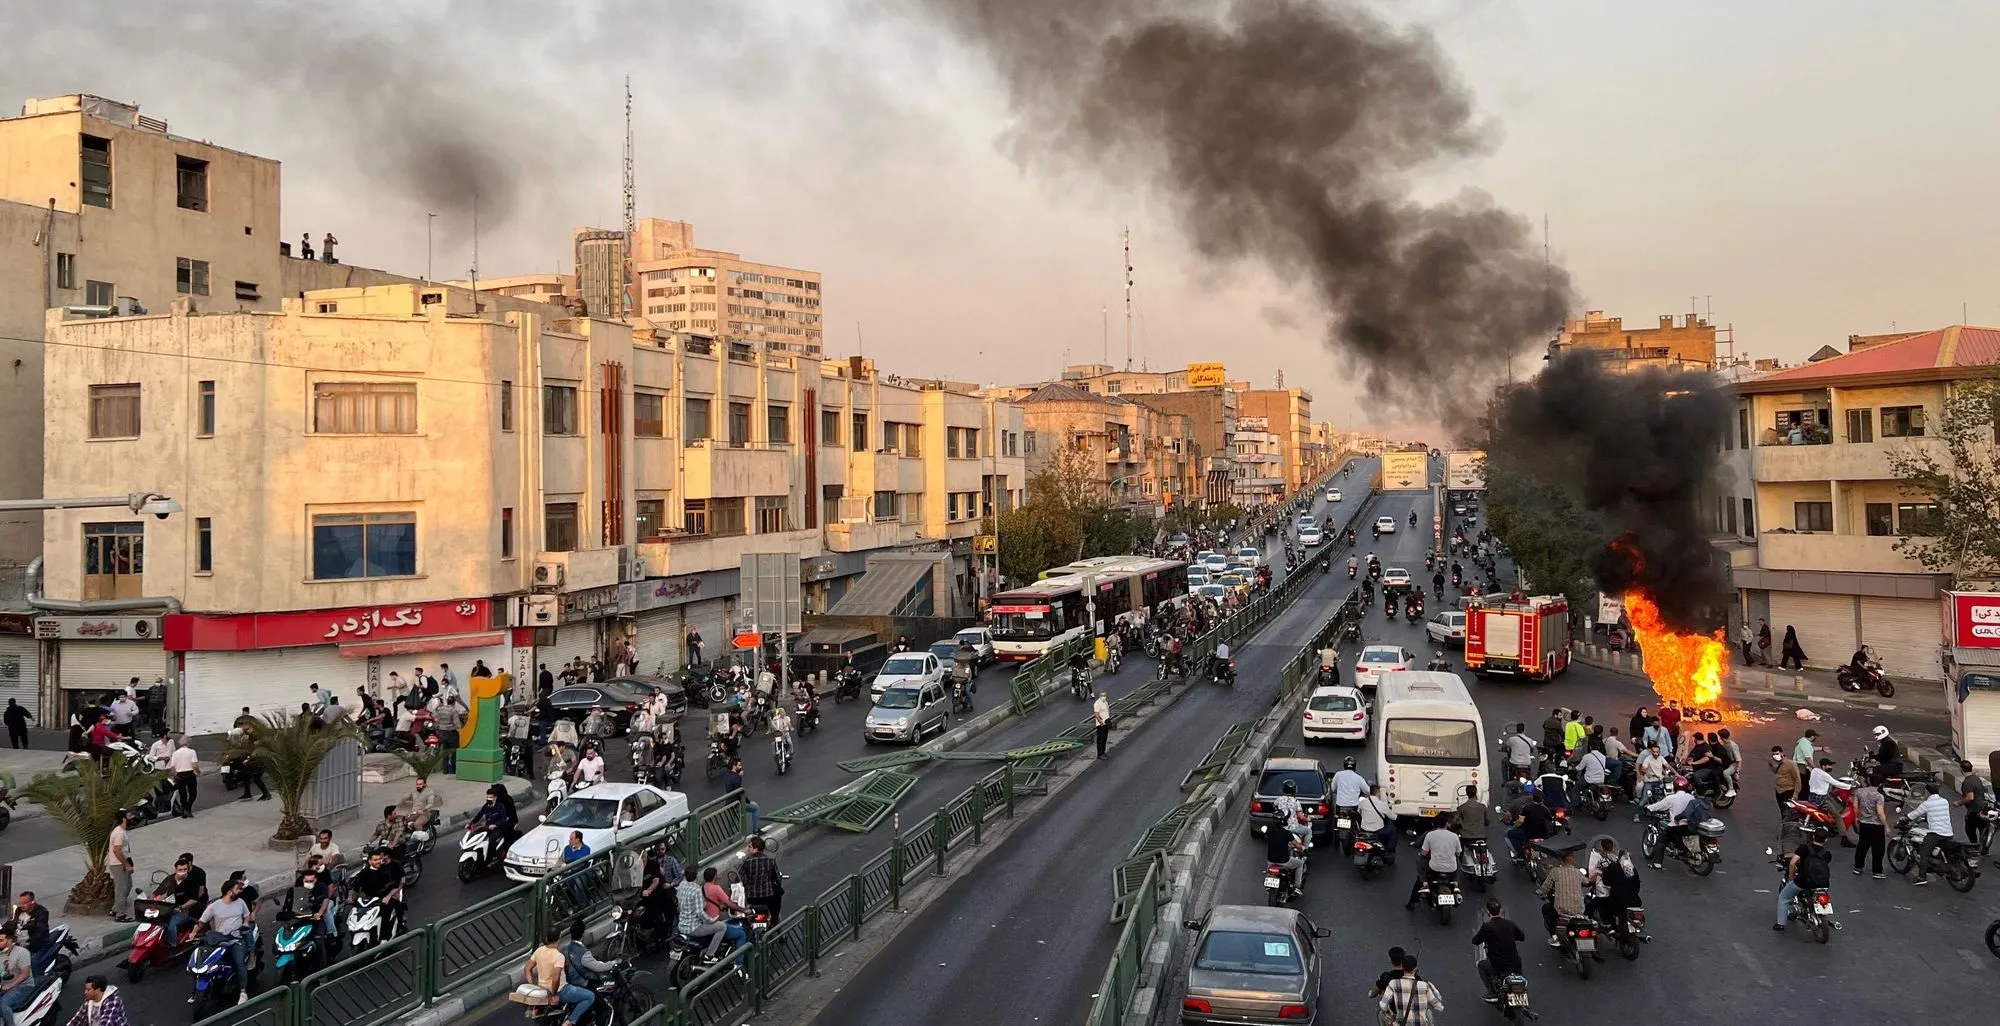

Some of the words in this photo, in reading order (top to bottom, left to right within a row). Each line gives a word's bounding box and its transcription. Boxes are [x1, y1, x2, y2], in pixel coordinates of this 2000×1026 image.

[1191, 374, 1220, 384] رزمندگان
[455, 601, 477, 615] ویژه
[323, 610, 380, 637] اژدر
[382, 608, 422, 627] تک
